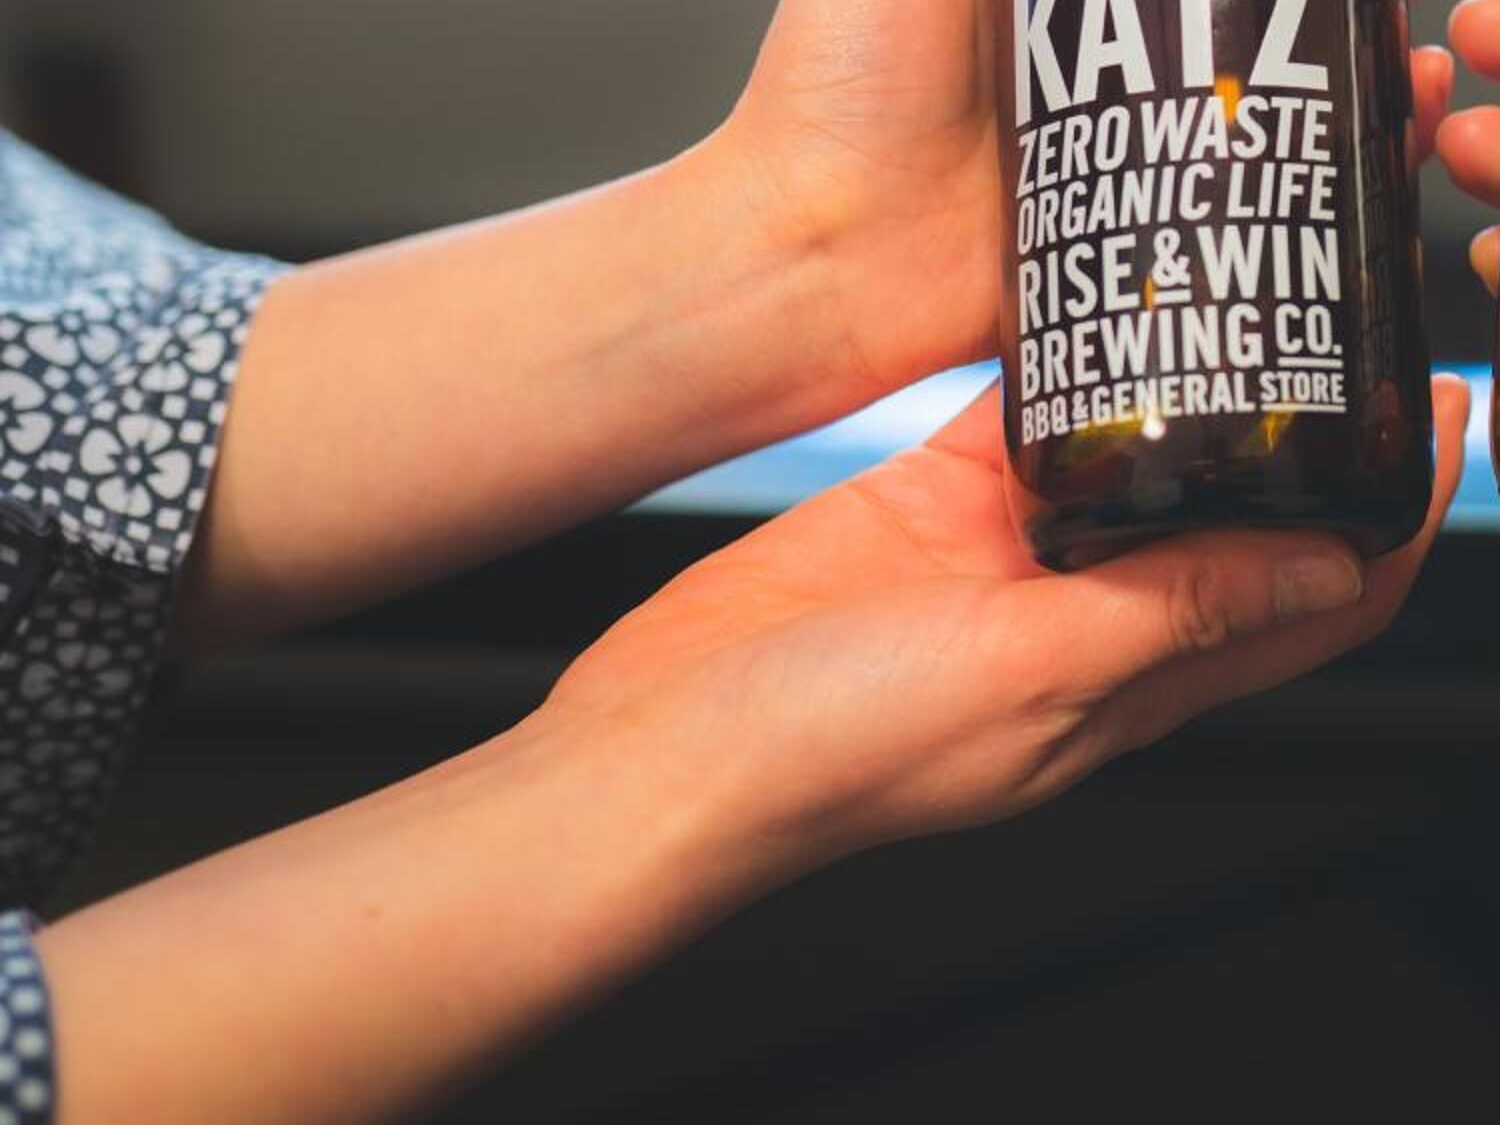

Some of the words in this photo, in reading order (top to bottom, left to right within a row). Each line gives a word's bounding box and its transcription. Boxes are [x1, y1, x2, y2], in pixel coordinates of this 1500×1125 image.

[1016, 105, 1131, 199] ZERO
[1141, 95, 1333, 164] WASTE
[1017, 164, 1214, 254] ORGANIC
[1226, 163, 1337, 220] LIFE
[1019, 235, 1140, 335] RISE
[1152, 228, 1191, 287] &
[1197, 225, 1341, 301] WIN
[1020, 304, 1263, 402] BREWING
[1275, 304, 1342, 356] CO.
[1260, 371, 1346, 405] STORE
